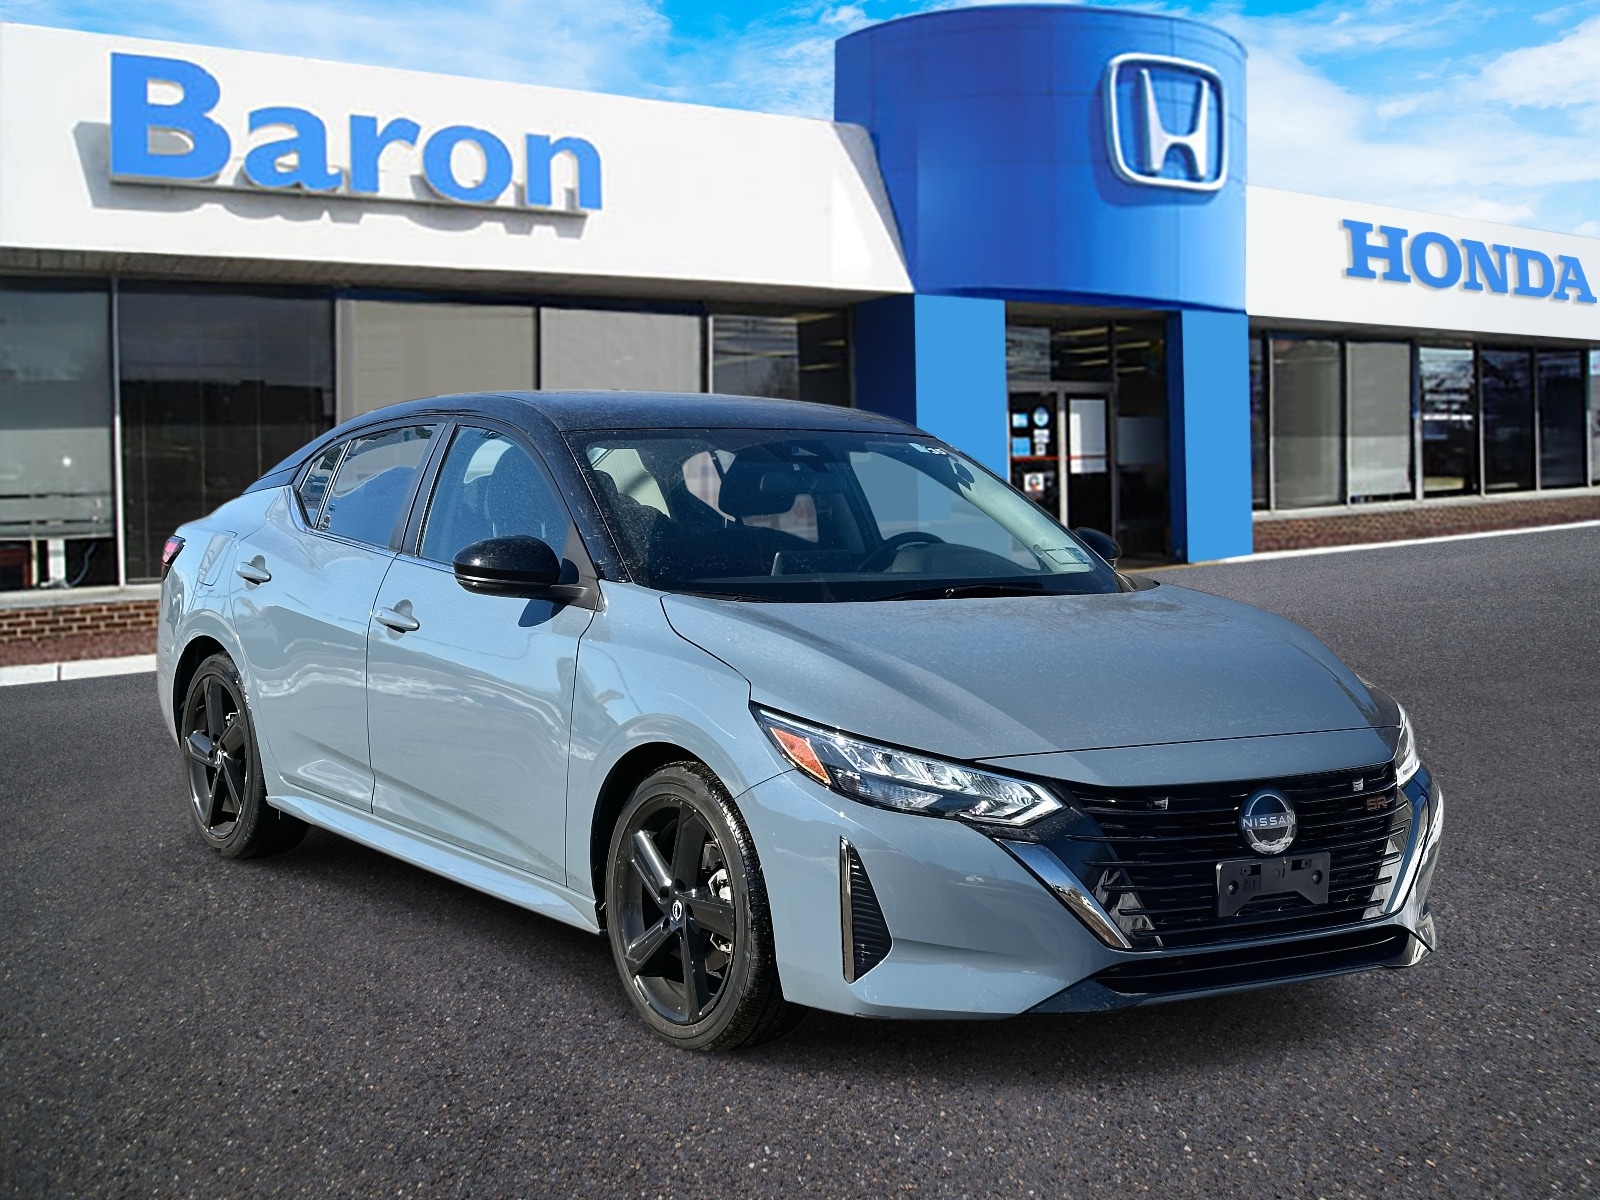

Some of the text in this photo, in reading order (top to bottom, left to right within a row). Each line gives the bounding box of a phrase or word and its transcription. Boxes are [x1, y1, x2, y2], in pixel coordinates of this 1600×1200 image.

[110, 52, 602, 210] Baron
[1343, 219, 1597, 304] HONDA
[1242, 814, 1294, 828] NISSAN
